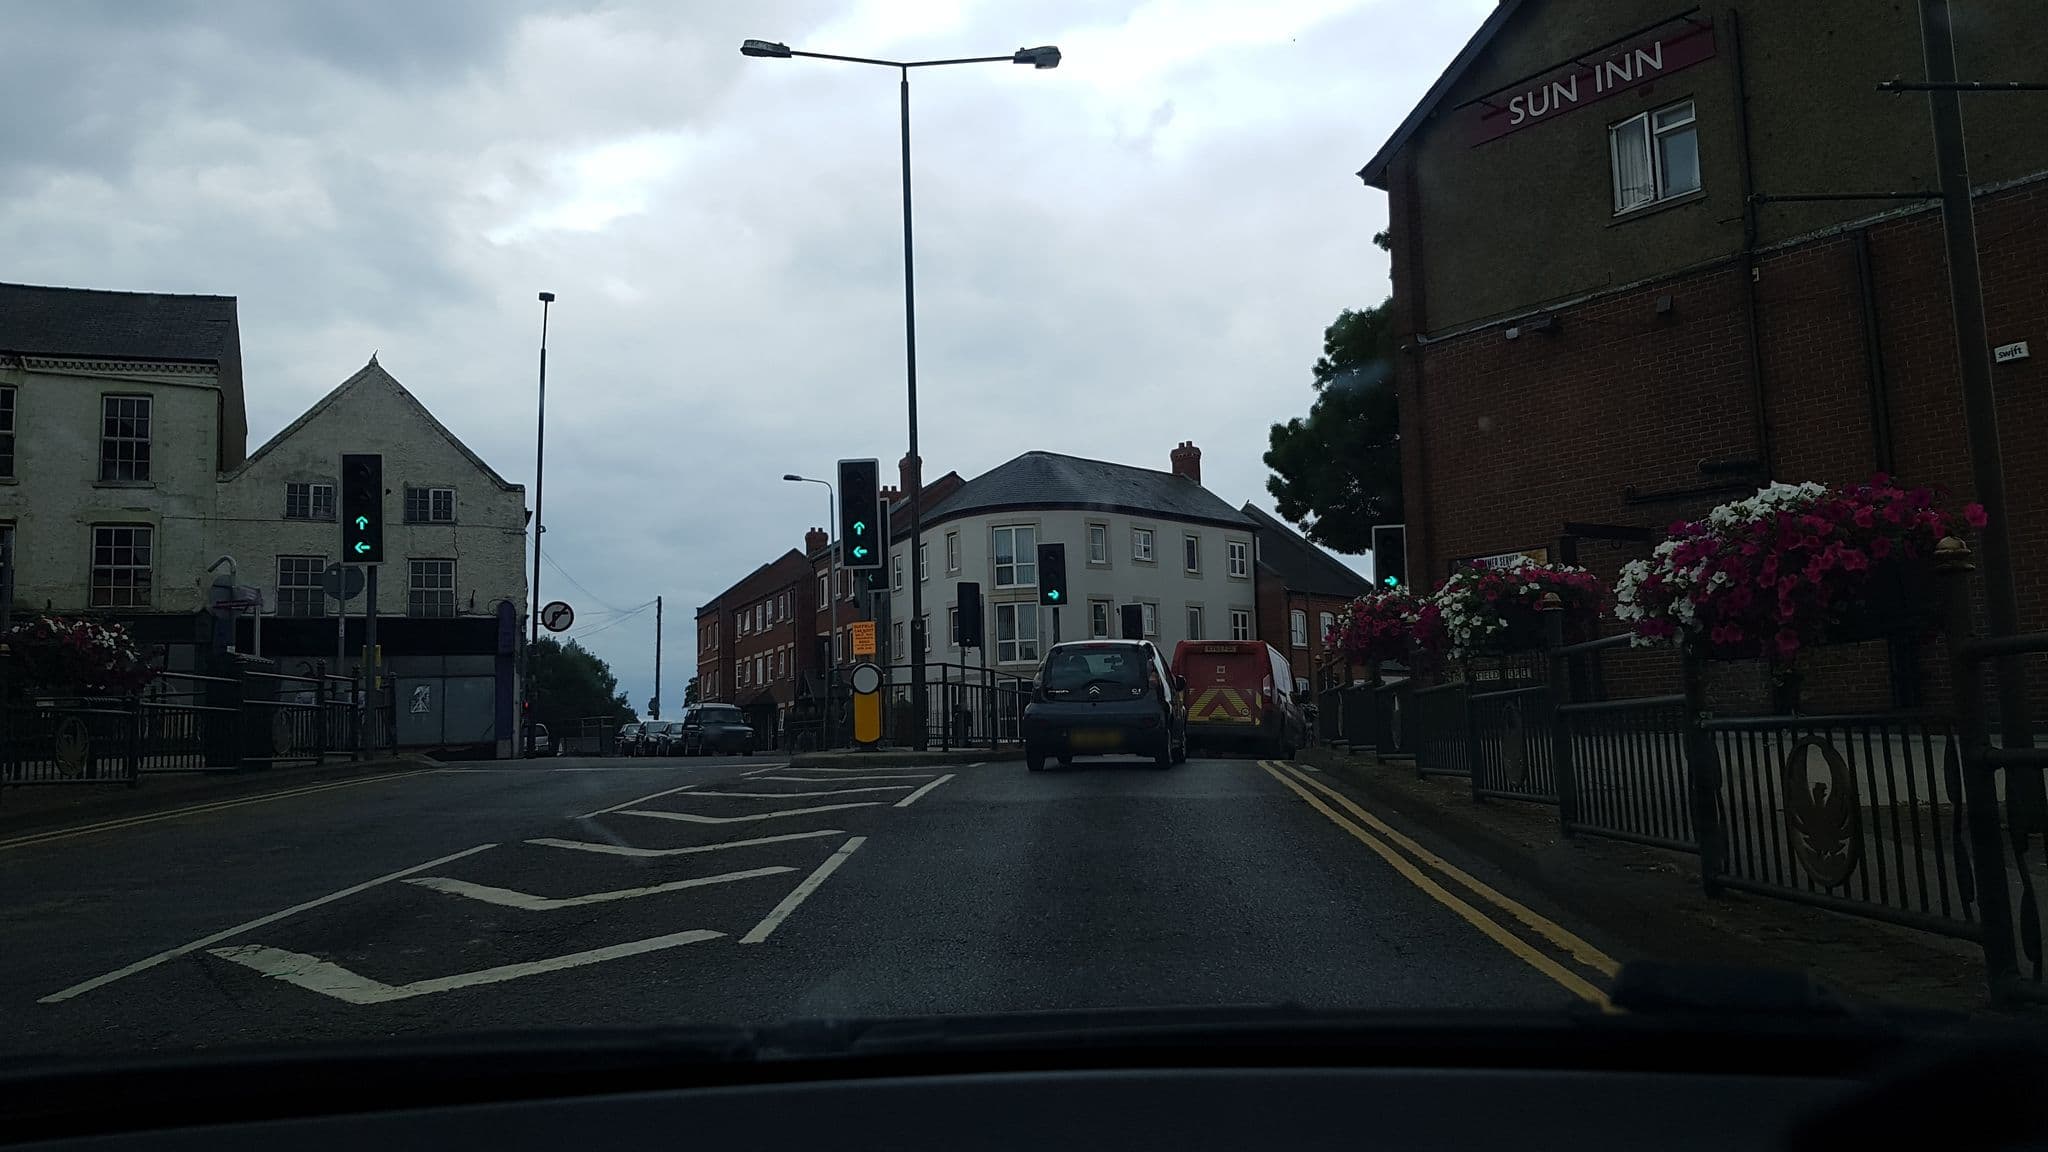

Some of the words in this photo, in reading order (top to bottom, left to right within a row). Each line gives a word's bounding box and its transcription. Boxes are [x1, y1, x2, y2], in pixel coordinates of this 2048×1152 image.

[1509, 74, 1578, 125] SUN
[1595, 41, 1663, 93] INN
[1998, 345, 2022, 359] swift
